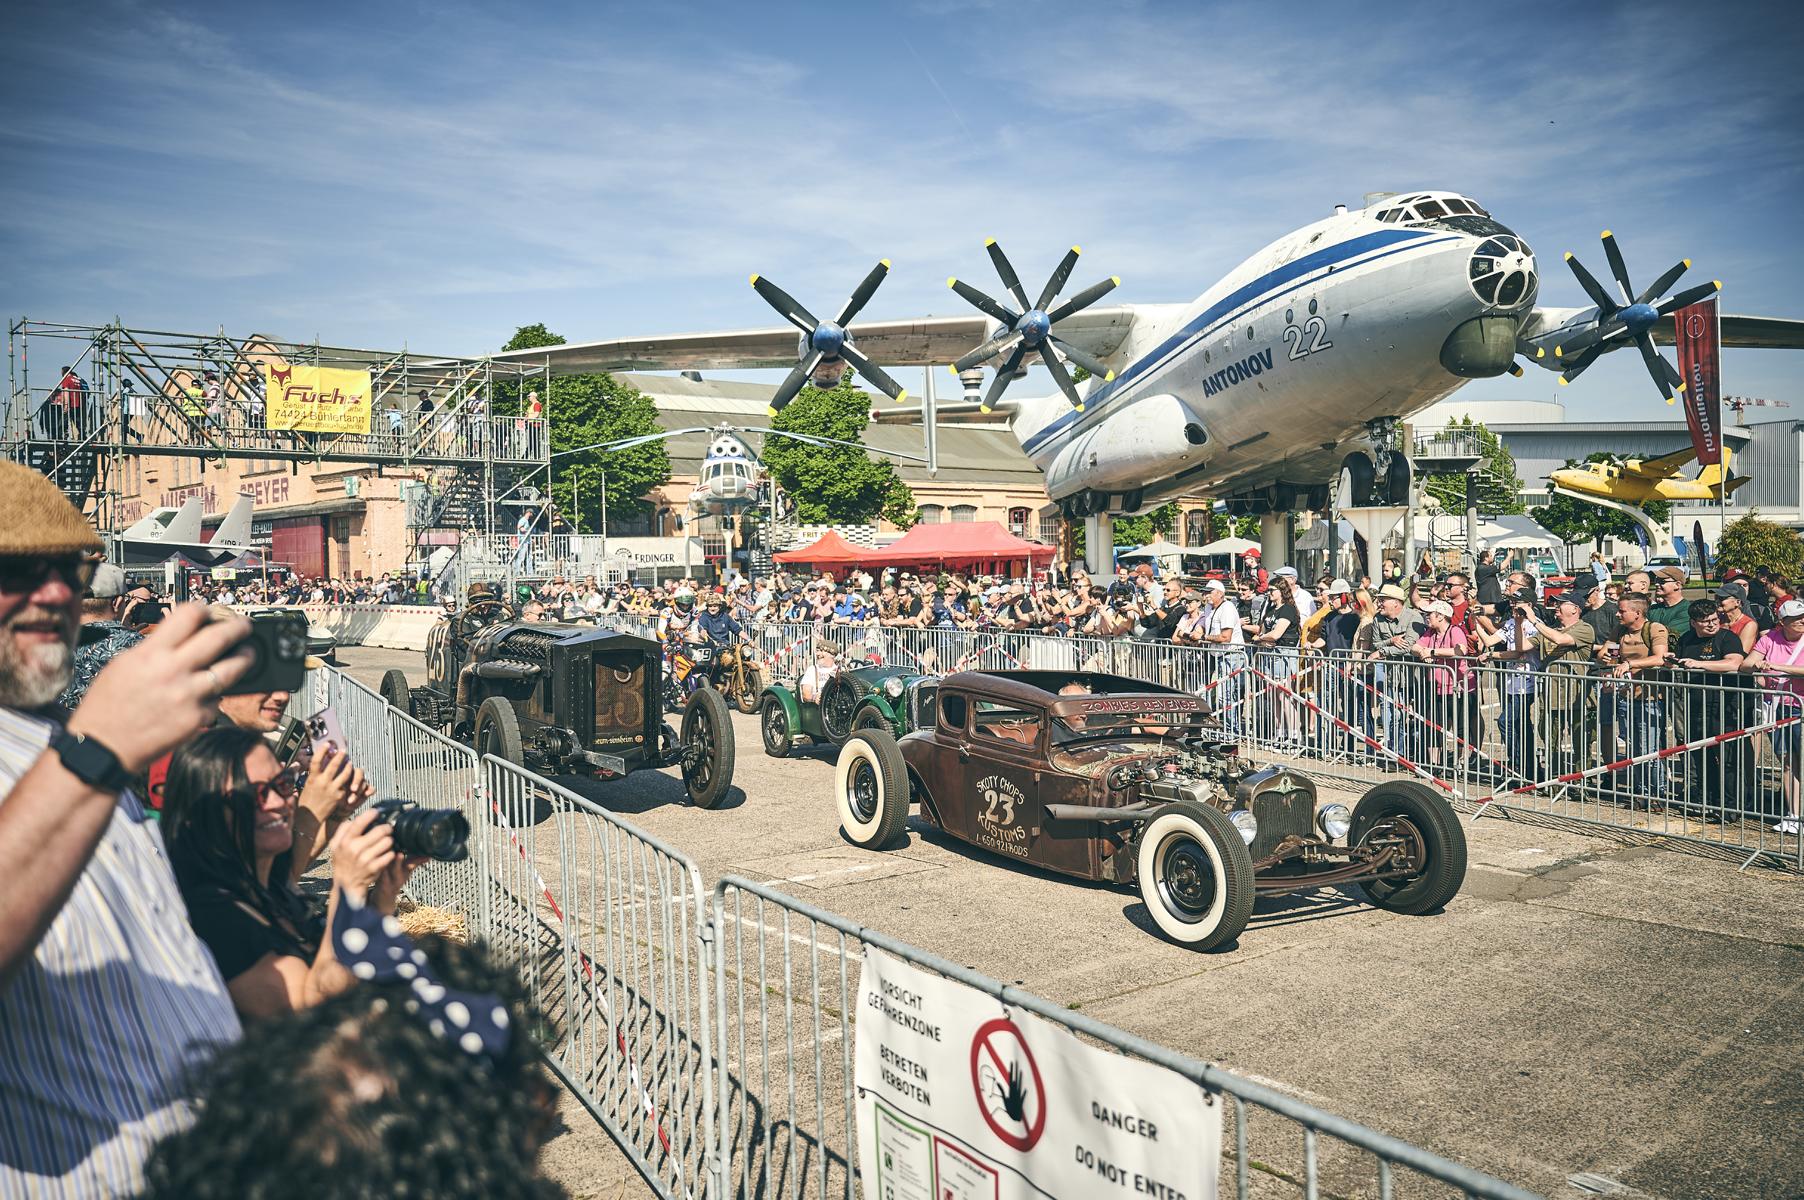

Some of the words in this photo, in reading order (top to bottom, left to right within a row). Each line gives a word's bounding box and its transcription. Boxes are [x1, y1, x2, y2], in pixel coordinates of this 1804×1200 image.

[1282, 315, 1334, 361] 22
[1202, 347, 1274, 398] ANTONOV
[283, 385, 363, 405] Fuchs
[274, 409, 306, 420] 74424
[1143, 699, 1200, 711] REVENGE
[976, 775, 999, 793] SKOTY
[1000, 777, 1025, 805] CHOPS
[984, 789, 1015, 826] 23
[977, 810, 1026, 842] KUSTOMS
[880, 1043, 928, 1082] BETRETEN
[880, 1066, 931, 1107] VERBOTEN
[1092, 1101, 1158, 1141] DANGER
[1075, 1145, 1094, 1169] DO
[1097, 1157, 1128, 1186] NOT
